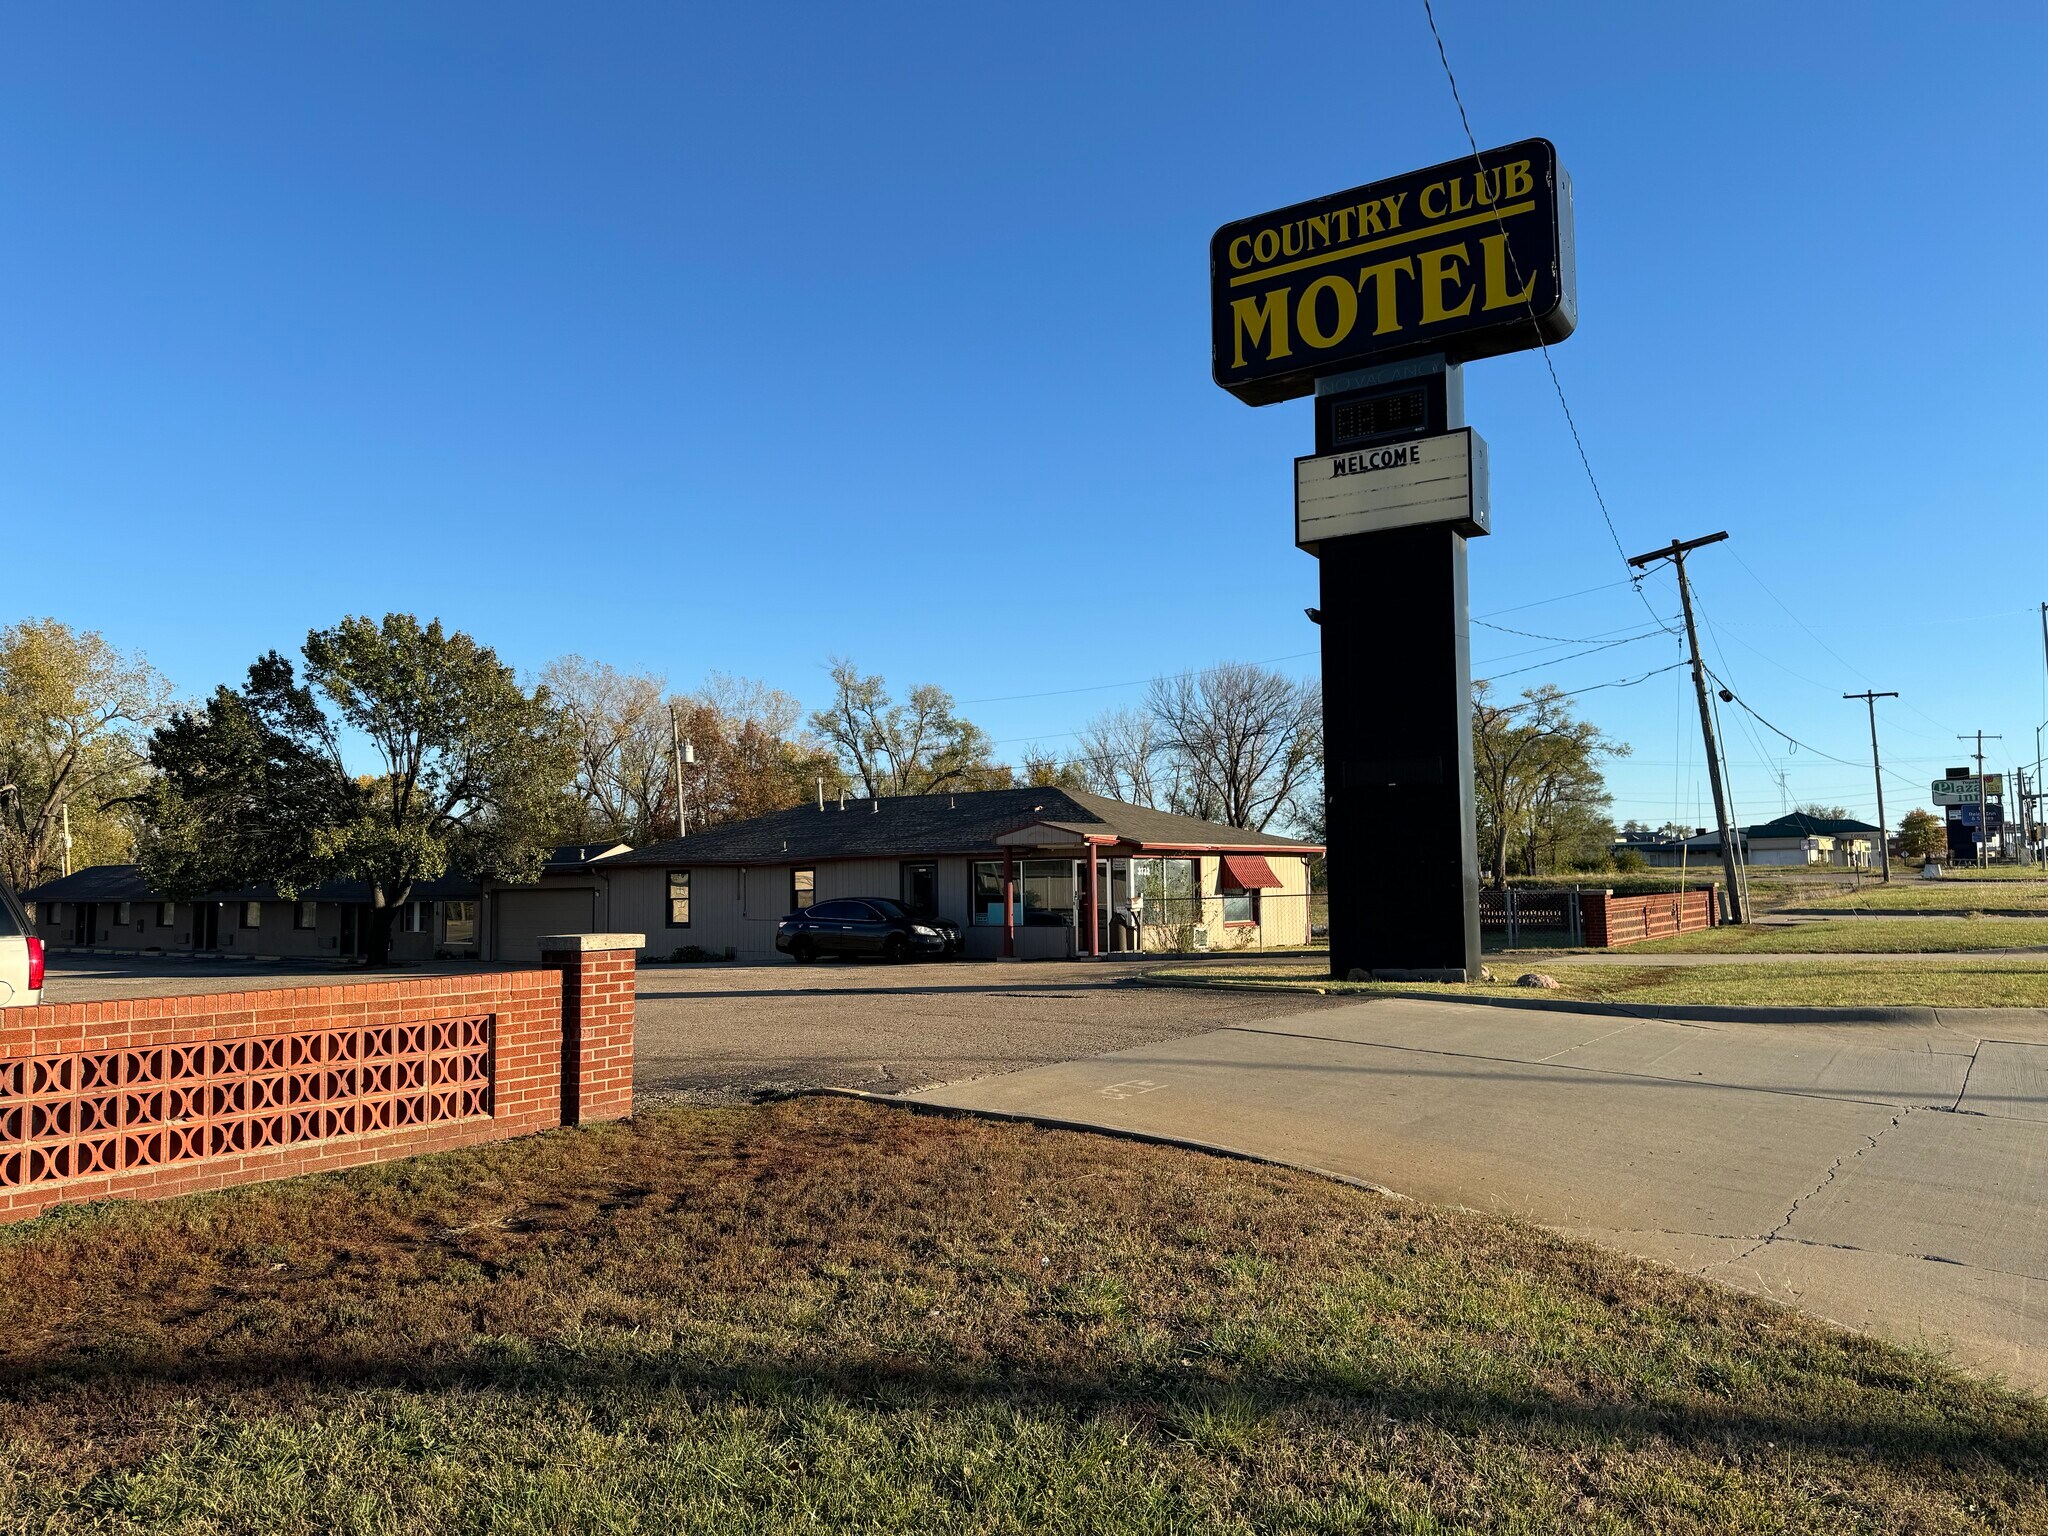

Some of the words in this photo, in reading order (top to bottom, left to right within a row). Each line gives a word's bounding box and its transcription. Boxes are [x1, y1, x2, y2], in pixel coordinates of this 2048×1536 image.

[1229, 192, 1408, 270] COUNTRY
[1419, 159, 1535, 219] CLUB
[1230, 232, 1538, 369] MOTEL
[1322, 377, 1350, 394] NO
[1333, 445, 1420, 475] WELCOME
